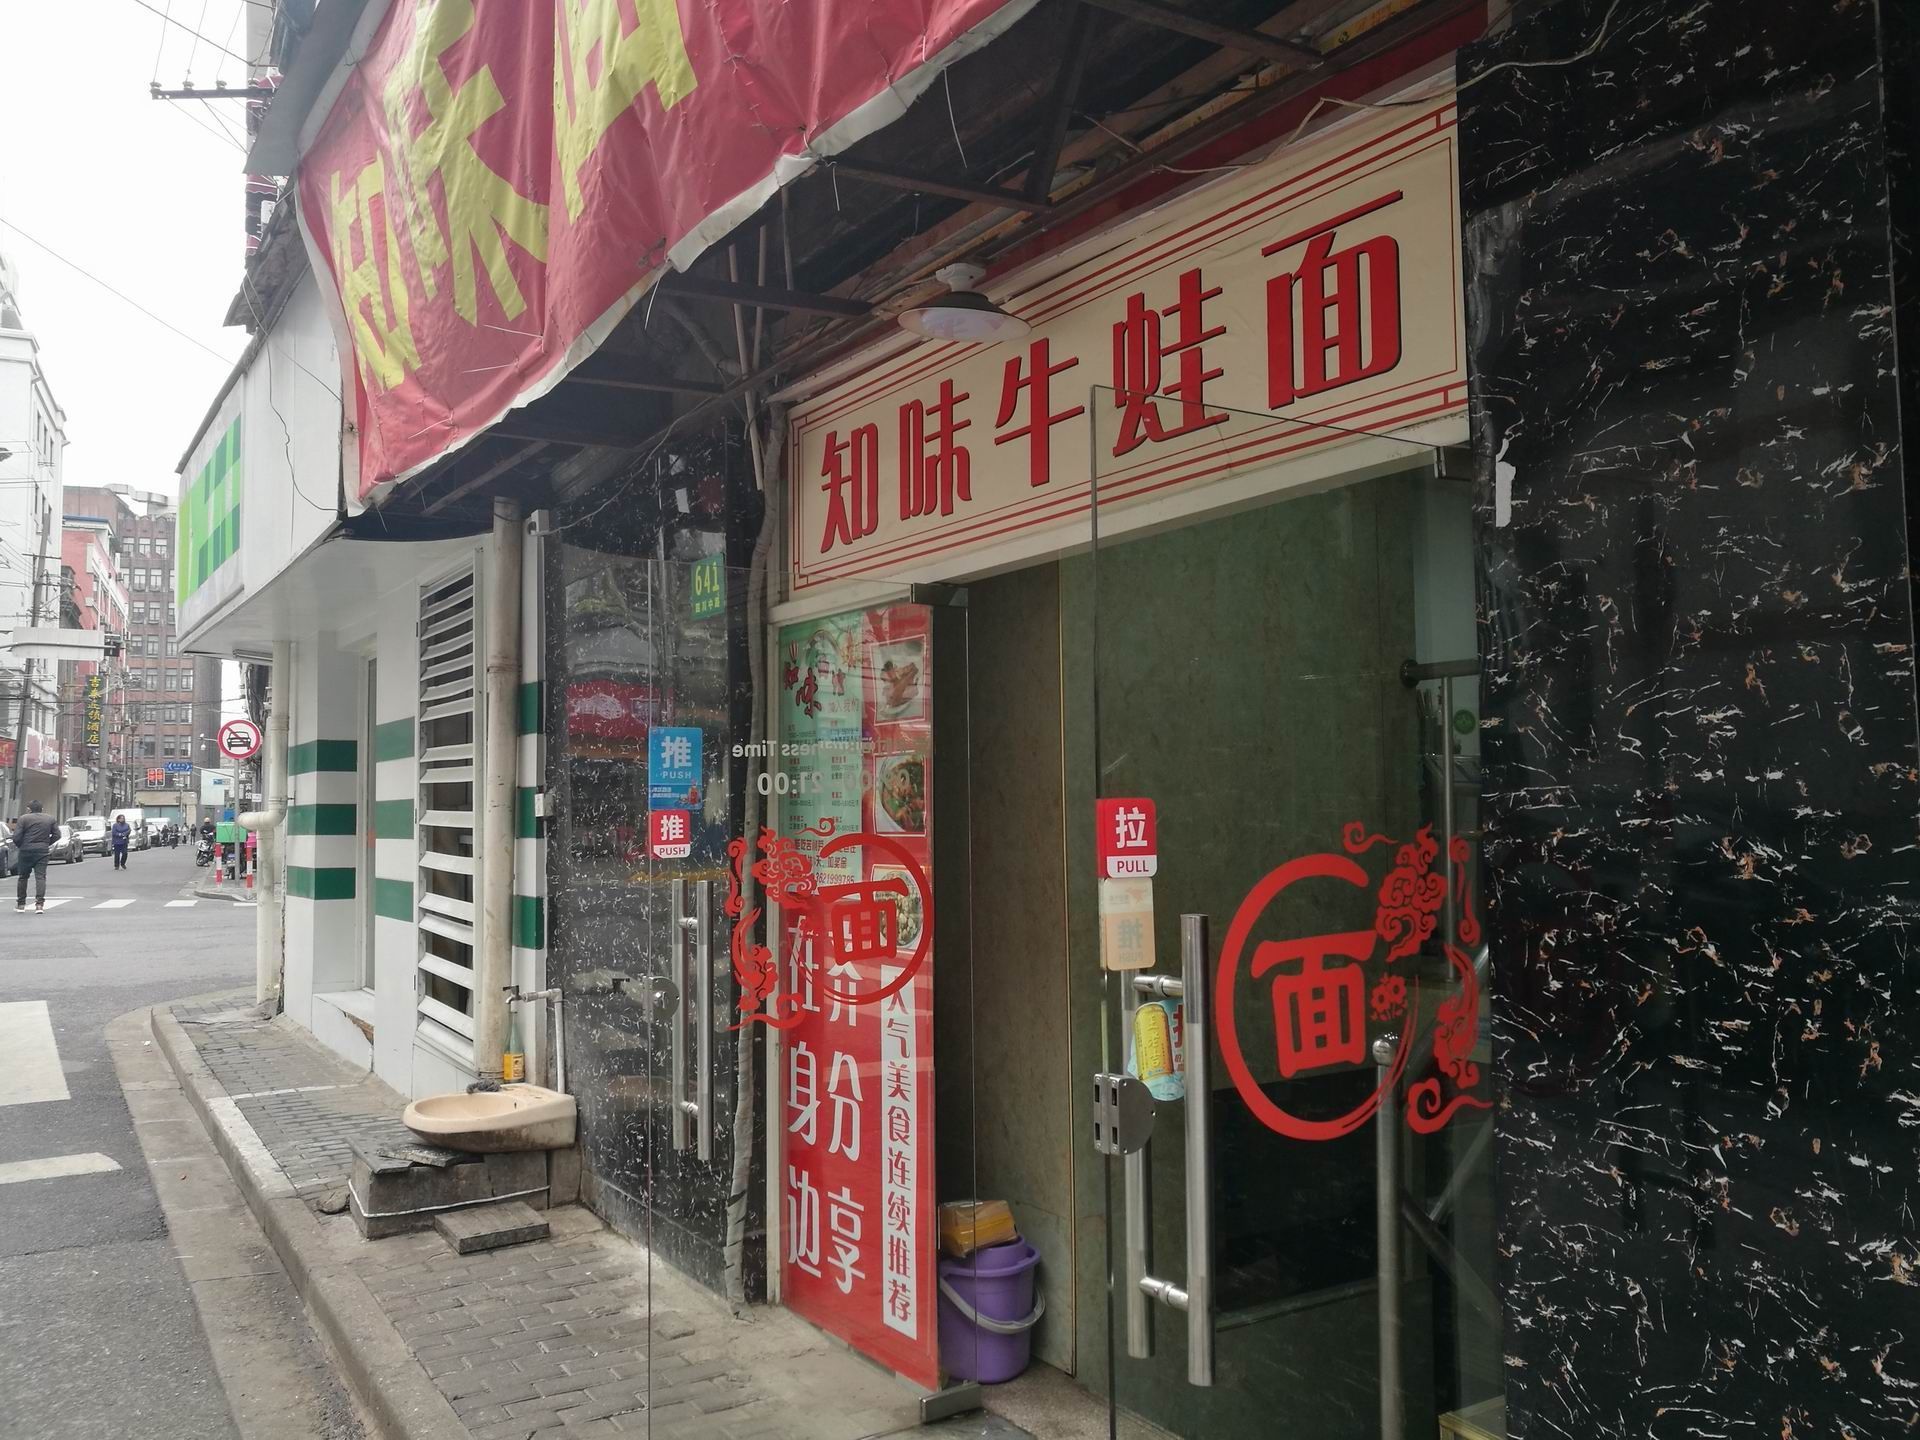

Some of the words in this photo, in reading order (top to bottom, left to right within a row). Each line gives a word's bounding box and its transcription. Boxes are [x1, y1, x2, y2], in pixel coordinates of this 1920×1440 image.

[820, 189, 1404, 555] 知味牛蛙面
[695, 561, 720, 596] 641
[661, 736, 692, 768] 推
[662, 771, 692, 780] PUSH
[660, 815, 684, 841] 推
[1115, 806, 1148, 849] 拉
[660, 847, 686, 856] PUSH
[1116, 860, 1149, 873] PULL
[1250, 929, 1378, 1079] 面
[886, 975, 913, 1322] 人气美食连续推荐
